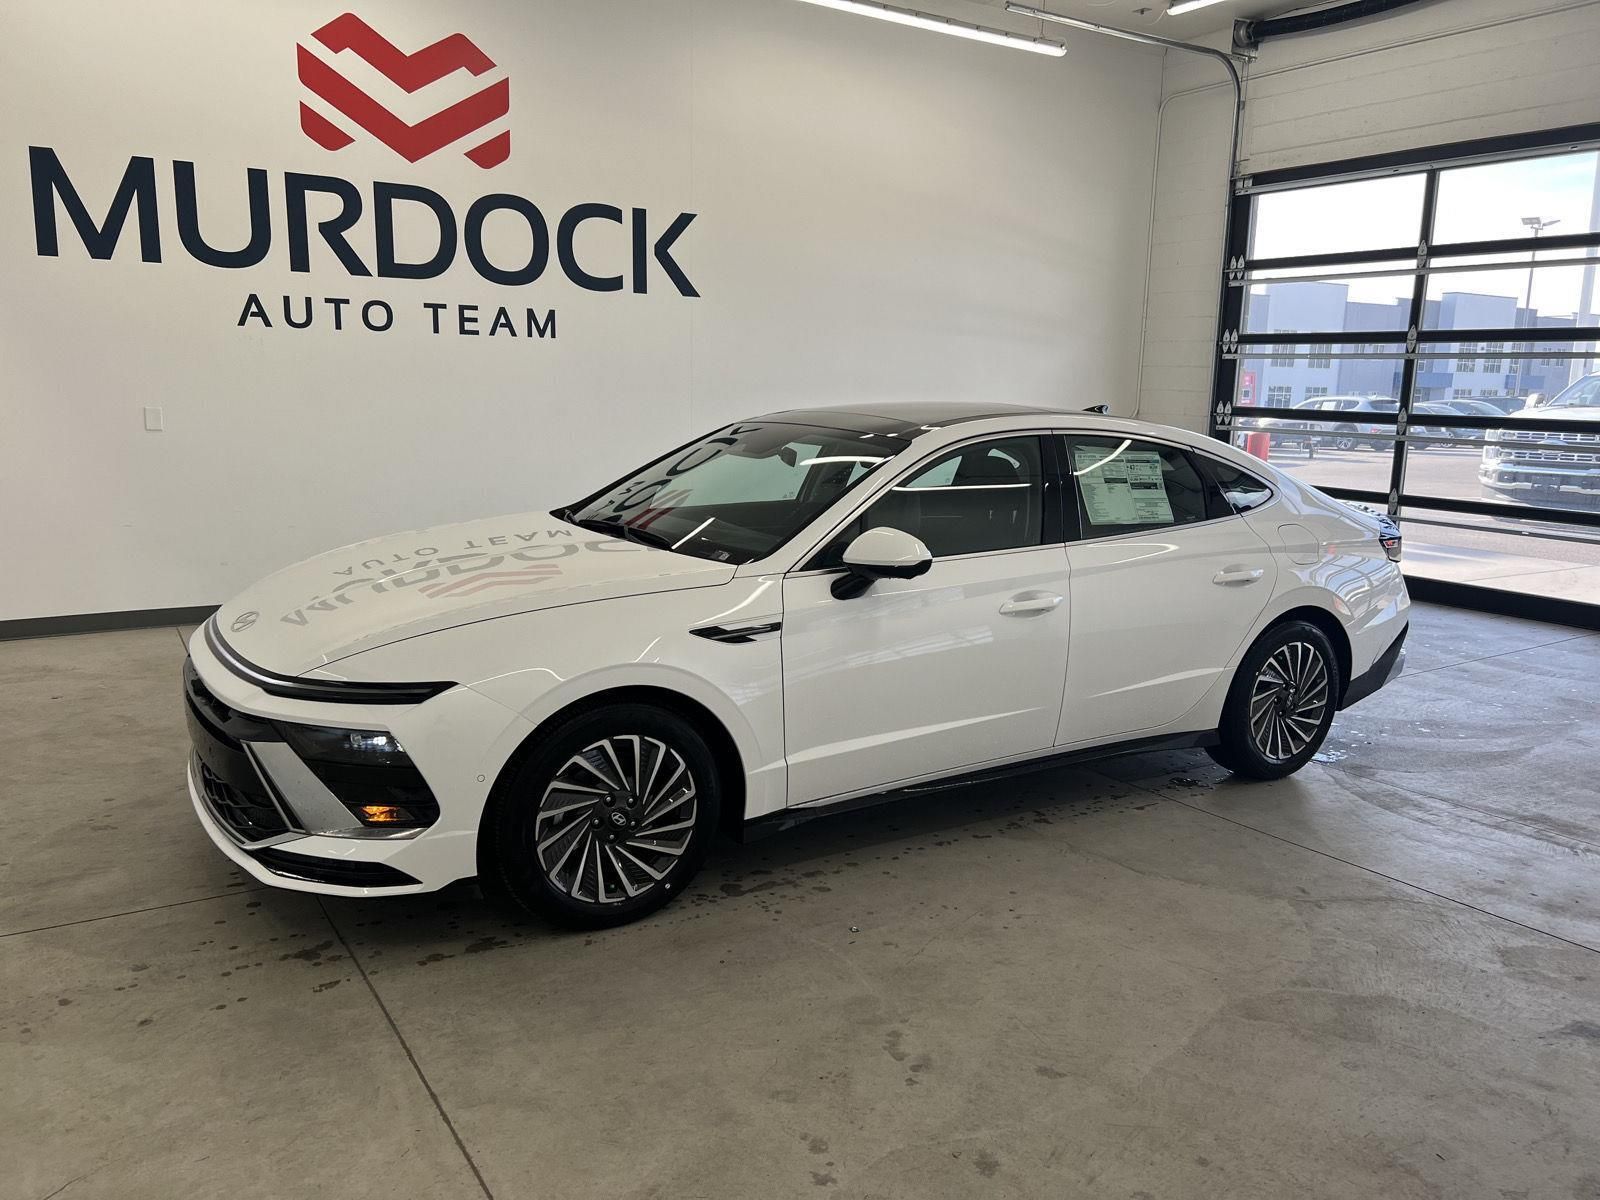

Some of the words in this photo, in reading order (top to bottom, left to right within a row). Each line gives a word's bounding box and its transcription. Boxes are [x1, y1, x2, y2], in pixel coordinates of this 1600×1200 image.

[29, 146, 701, 298] MURDOCK
[238, 294, 393, 332] AUTO
[424, 303, 557, 339] TEAM
